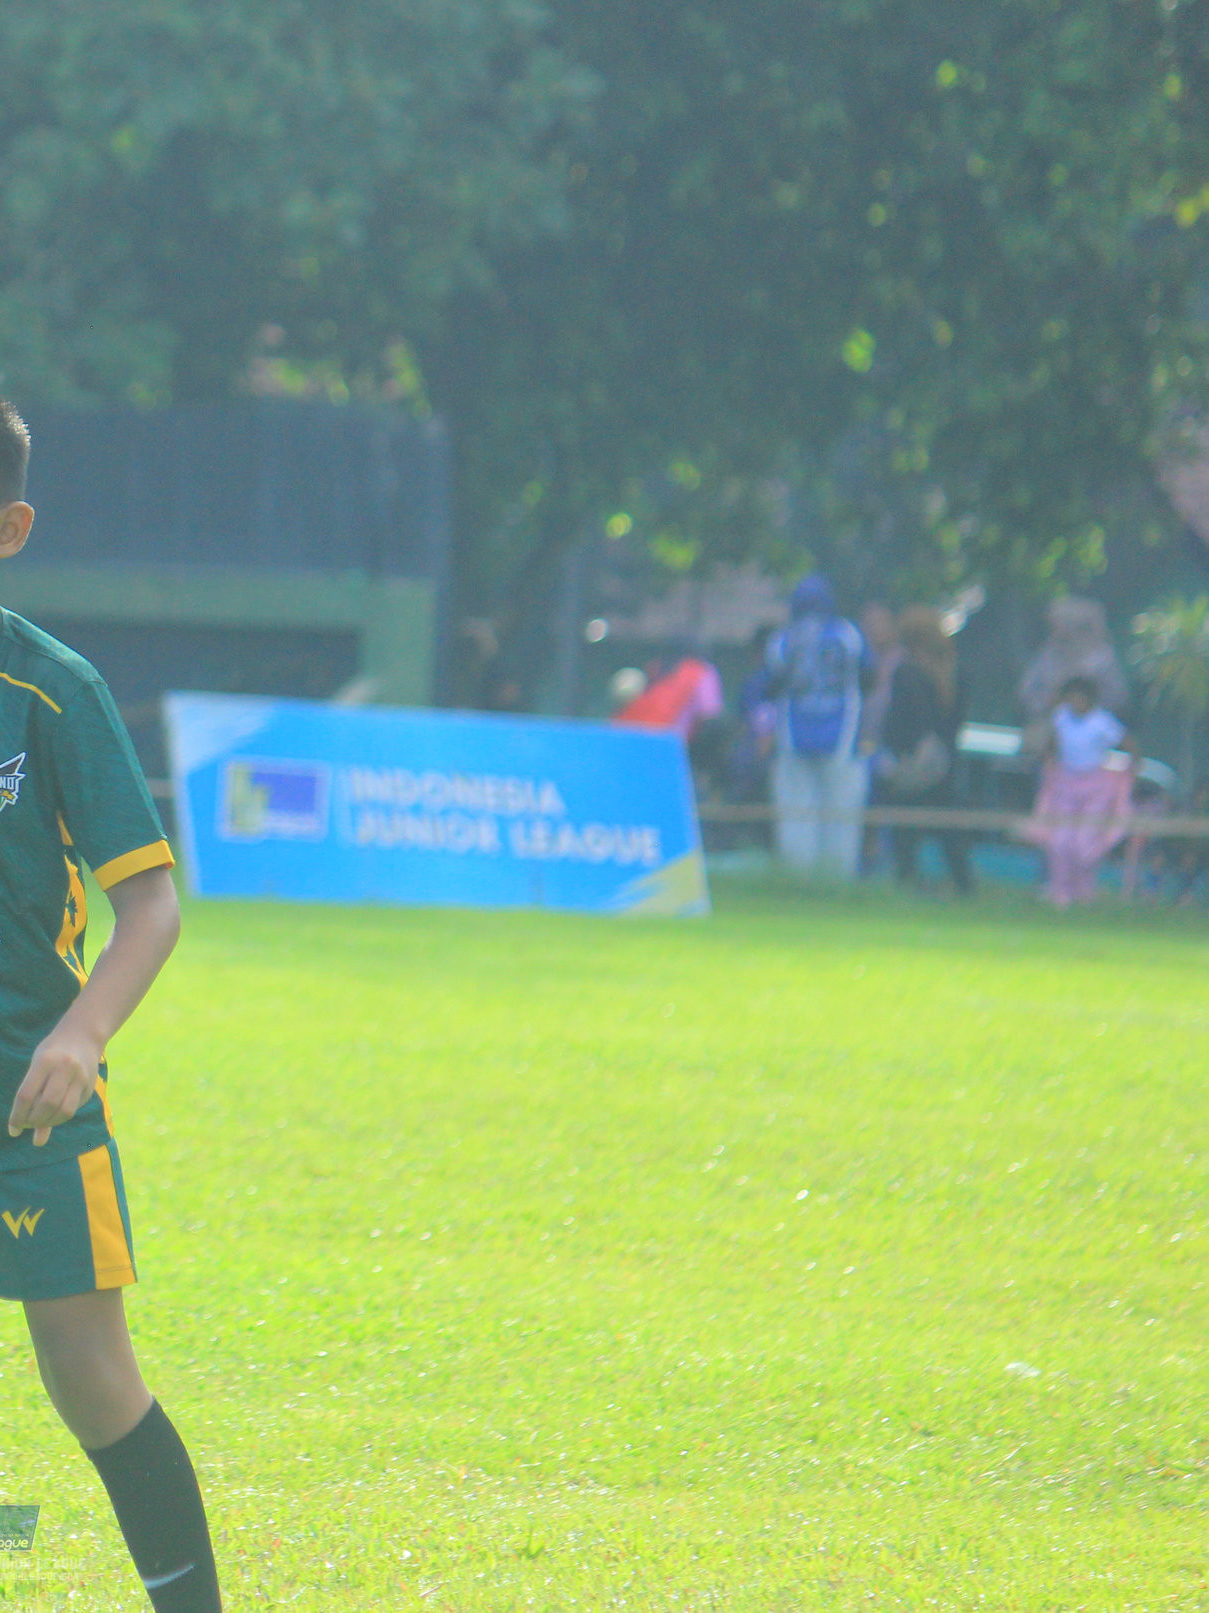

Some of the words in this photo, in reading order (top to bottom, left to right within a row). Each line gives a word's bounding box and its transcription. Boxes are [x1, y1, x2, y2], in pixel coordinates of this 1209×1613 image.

[352, 766, 566, 816] INDONESIA
[355, 809, 502, 853] JUNIOR
[510, 820, 662, 866] LEAGUE
